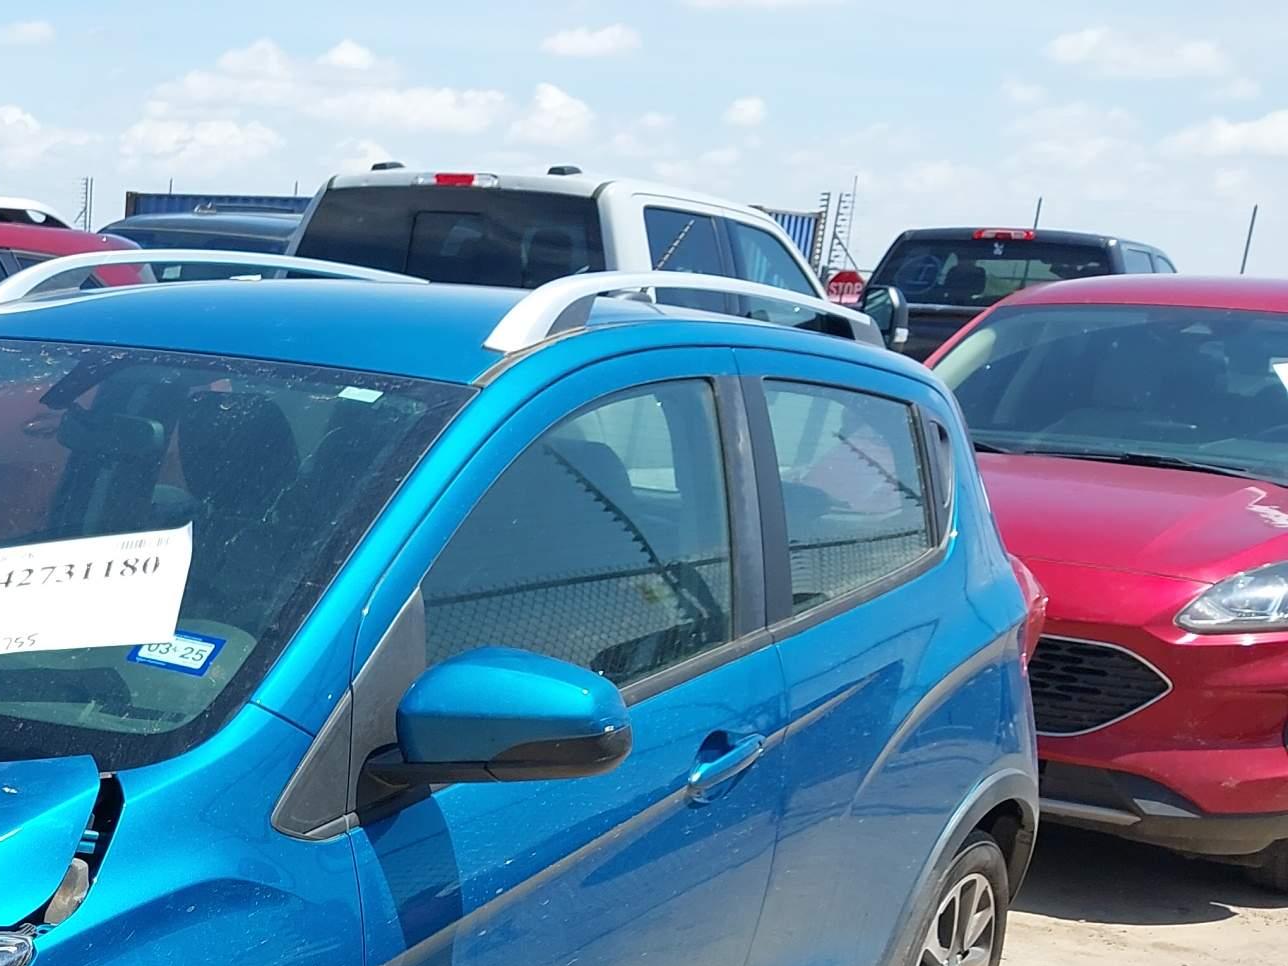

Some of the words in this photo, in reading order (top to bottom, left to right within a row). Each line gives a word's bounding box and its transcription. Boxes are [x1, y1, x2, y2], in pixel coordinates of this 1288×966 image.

[829, 282, 862, 295] STOP
[147, 642, 172, 654] 03
[179, 646, 207, 661] 25
